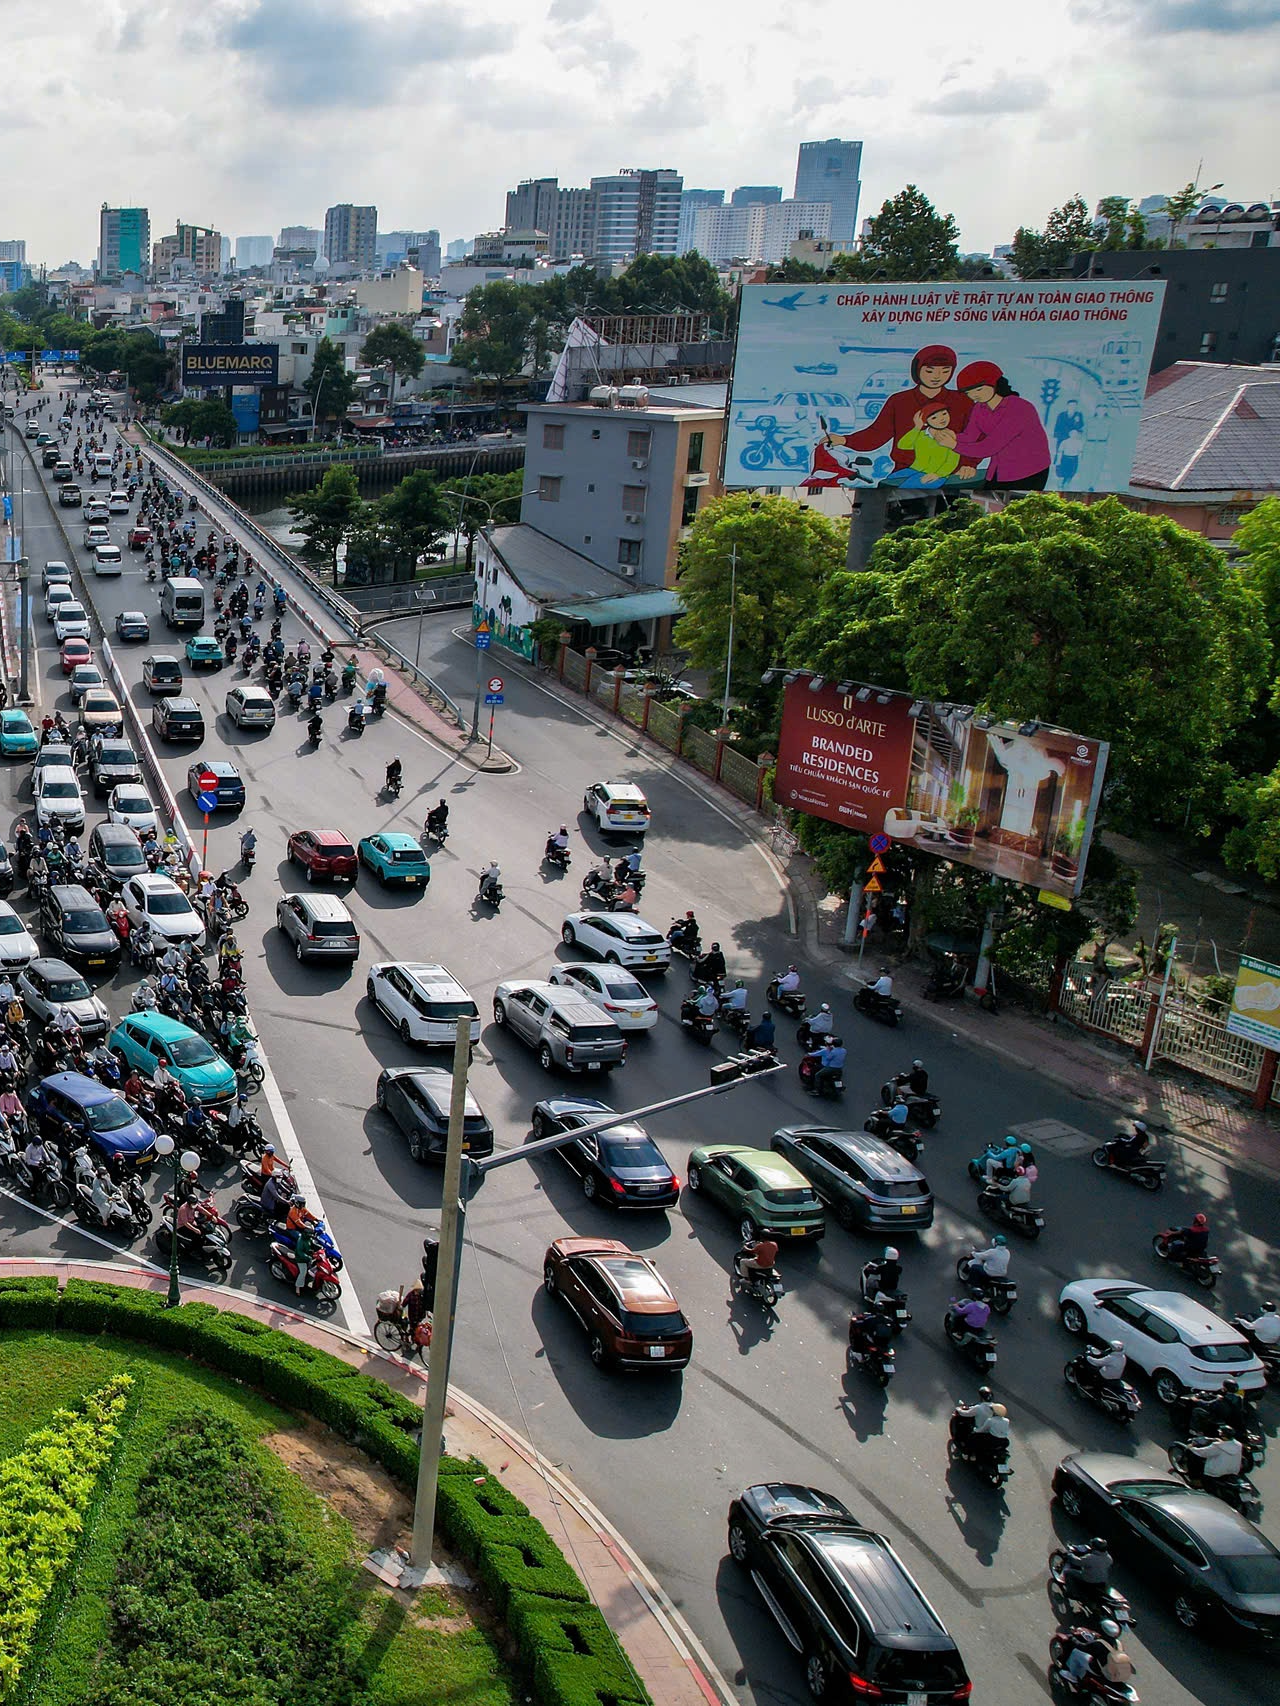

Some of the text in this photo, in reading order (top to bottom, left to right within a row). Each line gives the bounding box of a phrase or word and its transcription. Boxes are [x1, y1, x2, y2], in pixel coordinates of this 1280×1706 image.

[836, 289, 1154, 307] CHẤP HÀNH LUẬT VỀ TRẬT TỰ AN TOÀN GIAO THÔNG
[861, 306, 1128, 325] XÂY DỰNG NẾP SỐNG VĂN HÓA GIAO THÔNG
[186, 355, 273, 369] BLUEMARQ
[806, 705, 844, 727] LUSSO
[811, 735, 873, 763] BRANDED
[802, 751, 880, 784] RESIDENCES
[789, 764, 803, 774] TIÊU
[826, 774, 847, 786] KHÁCH
[848, 781, 861, 790] SẠN
[862, 782, 881, 796] QUỐC
